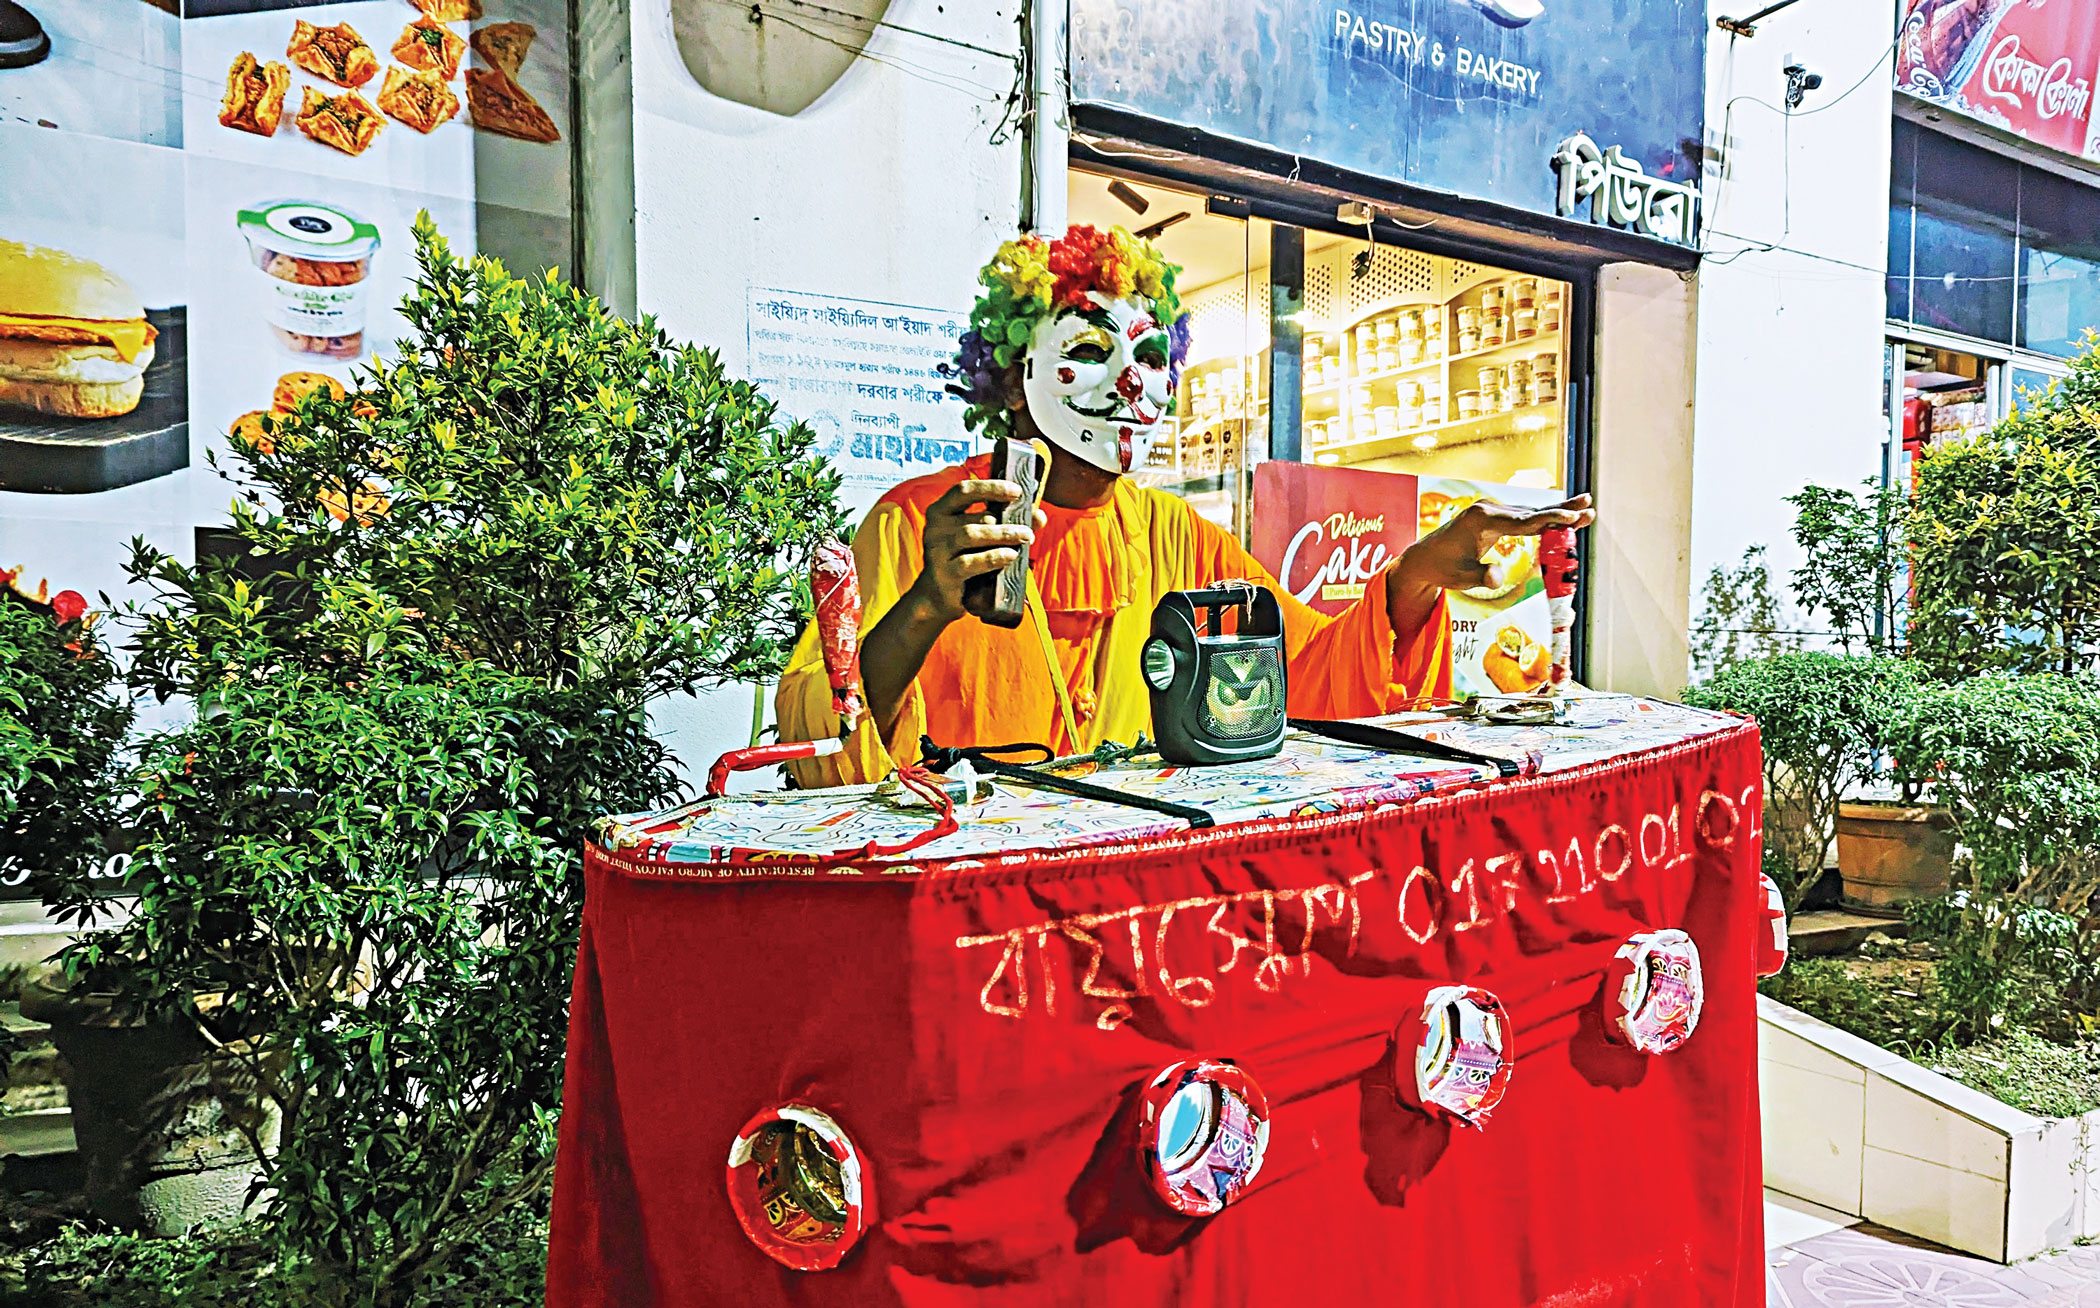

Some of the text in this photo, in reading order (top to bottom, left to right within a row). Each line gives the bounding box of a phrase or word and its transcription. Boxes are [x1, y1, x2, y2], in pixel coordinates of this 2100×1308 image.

[1335, 9, 1541, 94] PASTRY & BAKERY
[856, 382, 897, 401] দরবার
[849, 423, 971, 468] মাহফিল
[1322, 511, 1384, 540] Delicious
[1279, 520, 1393, 606] Cake
[1452, 620, 1478, 633] ORY
[1454, 635, 1479, 664] ght
[717, 867, 733, 878] OF
